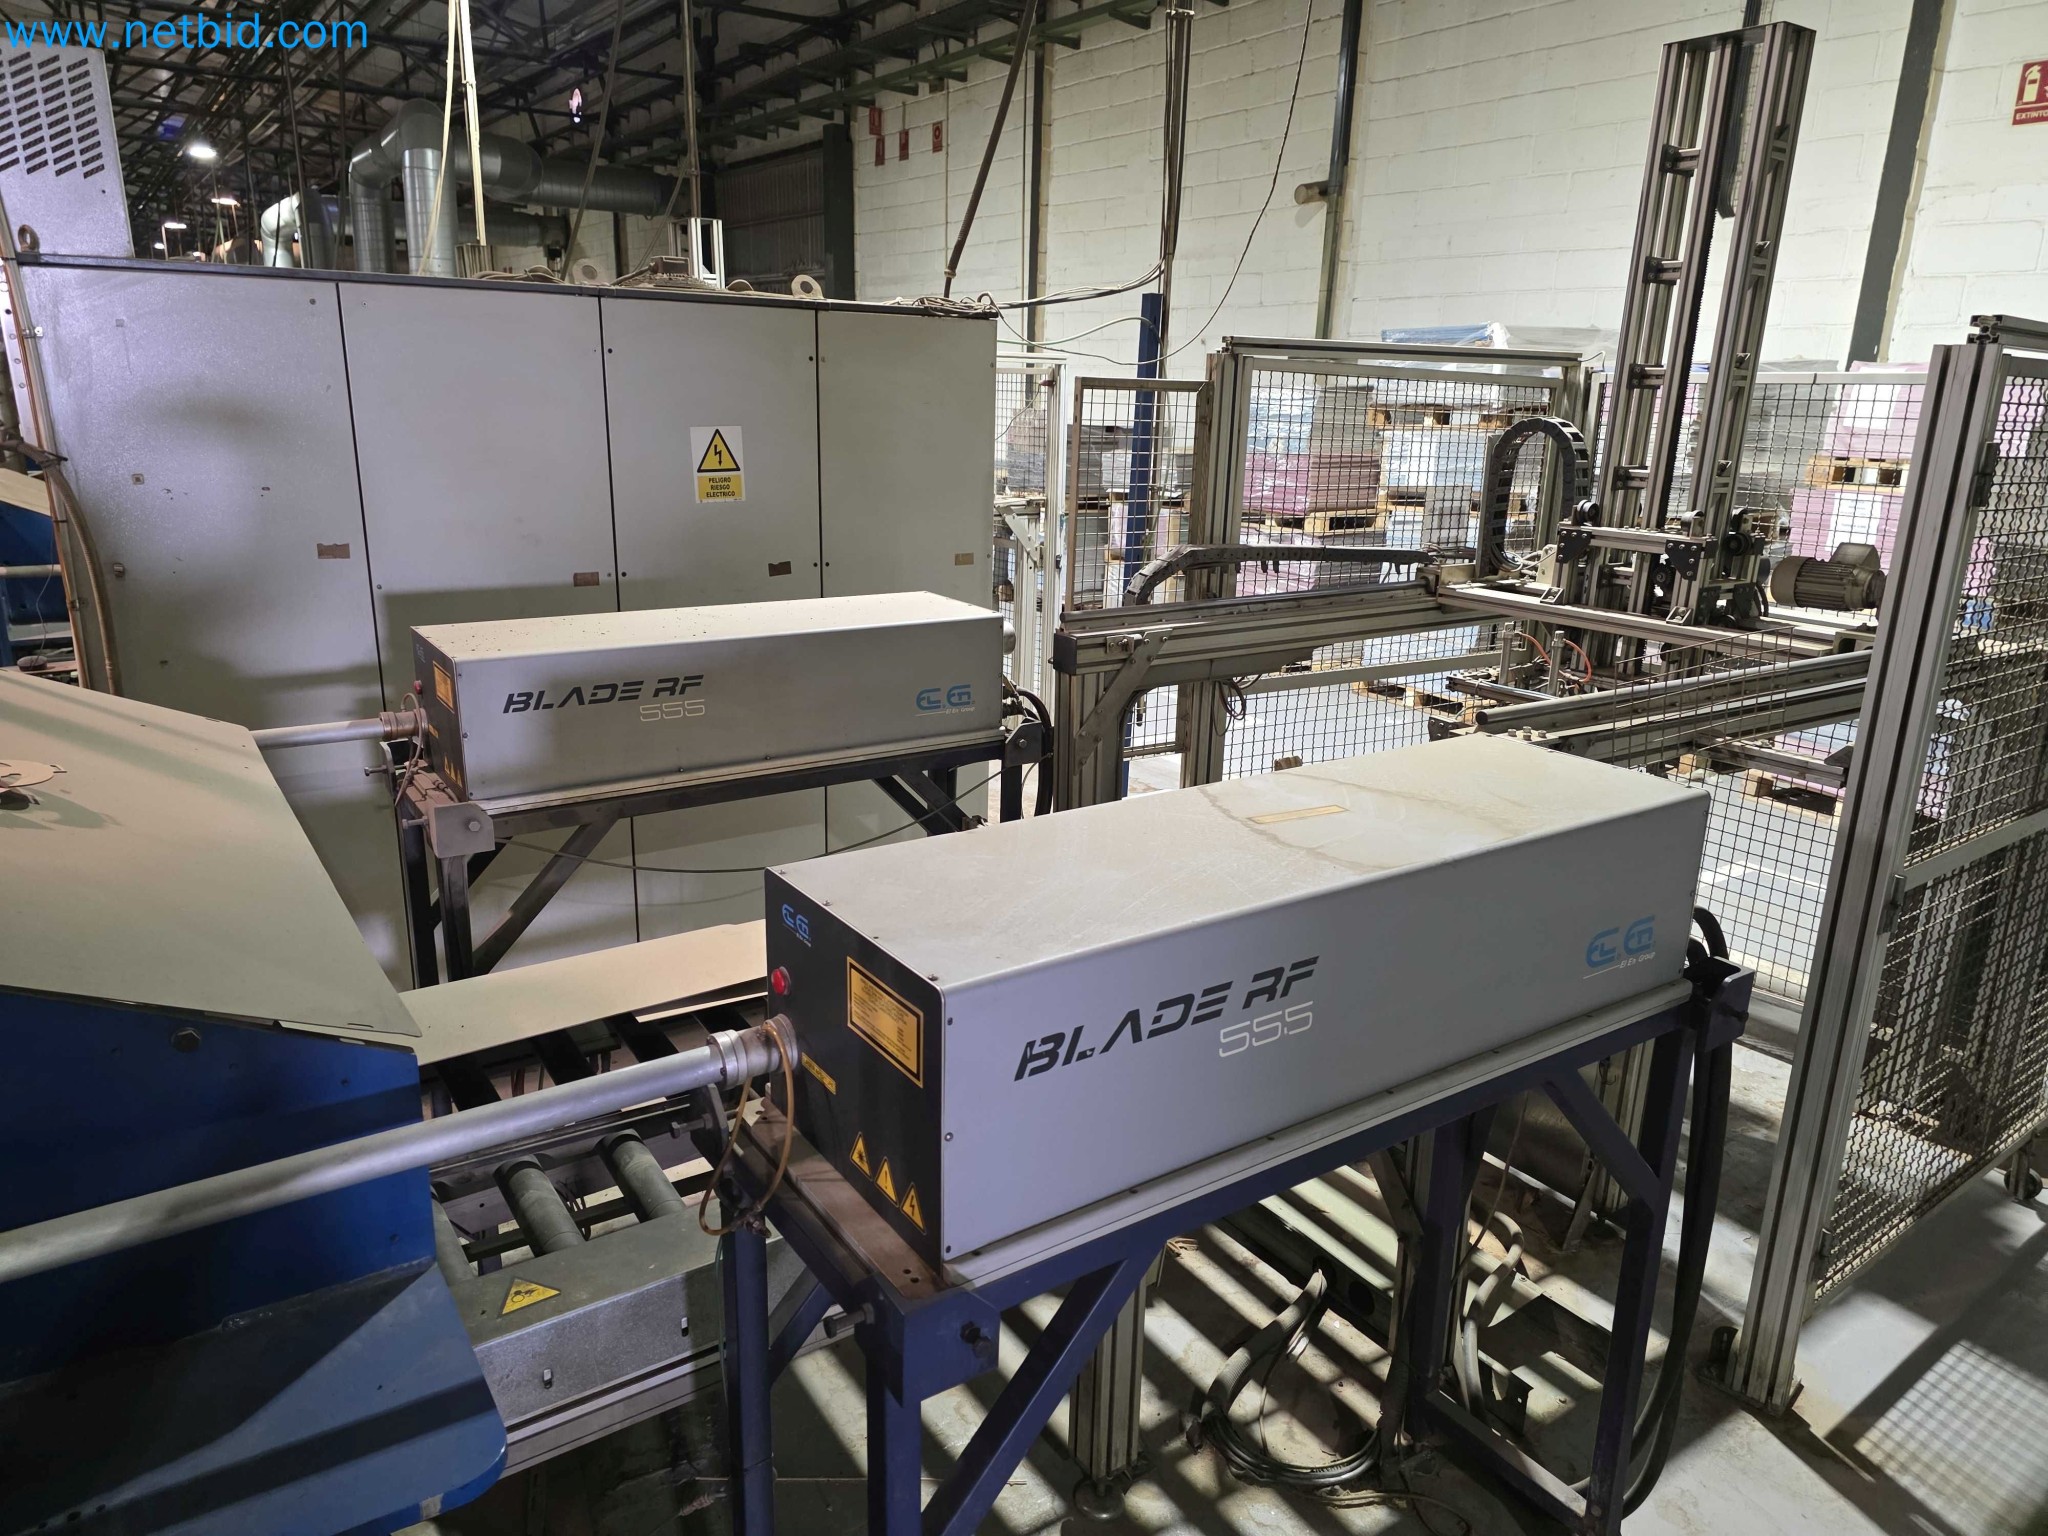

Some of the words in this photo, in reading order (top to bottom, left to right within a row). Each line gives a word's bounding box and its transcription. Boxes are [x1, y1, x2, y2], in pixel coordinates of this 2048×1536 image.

[706, 490, 736, 498] ELECTRICO
[502, 680, 645, 714] BLADE
[652, 674, 704, 698] RF
[1013, 980, 1235, 1082] BLADE
[1242, 955, 1320, 1010] RF
